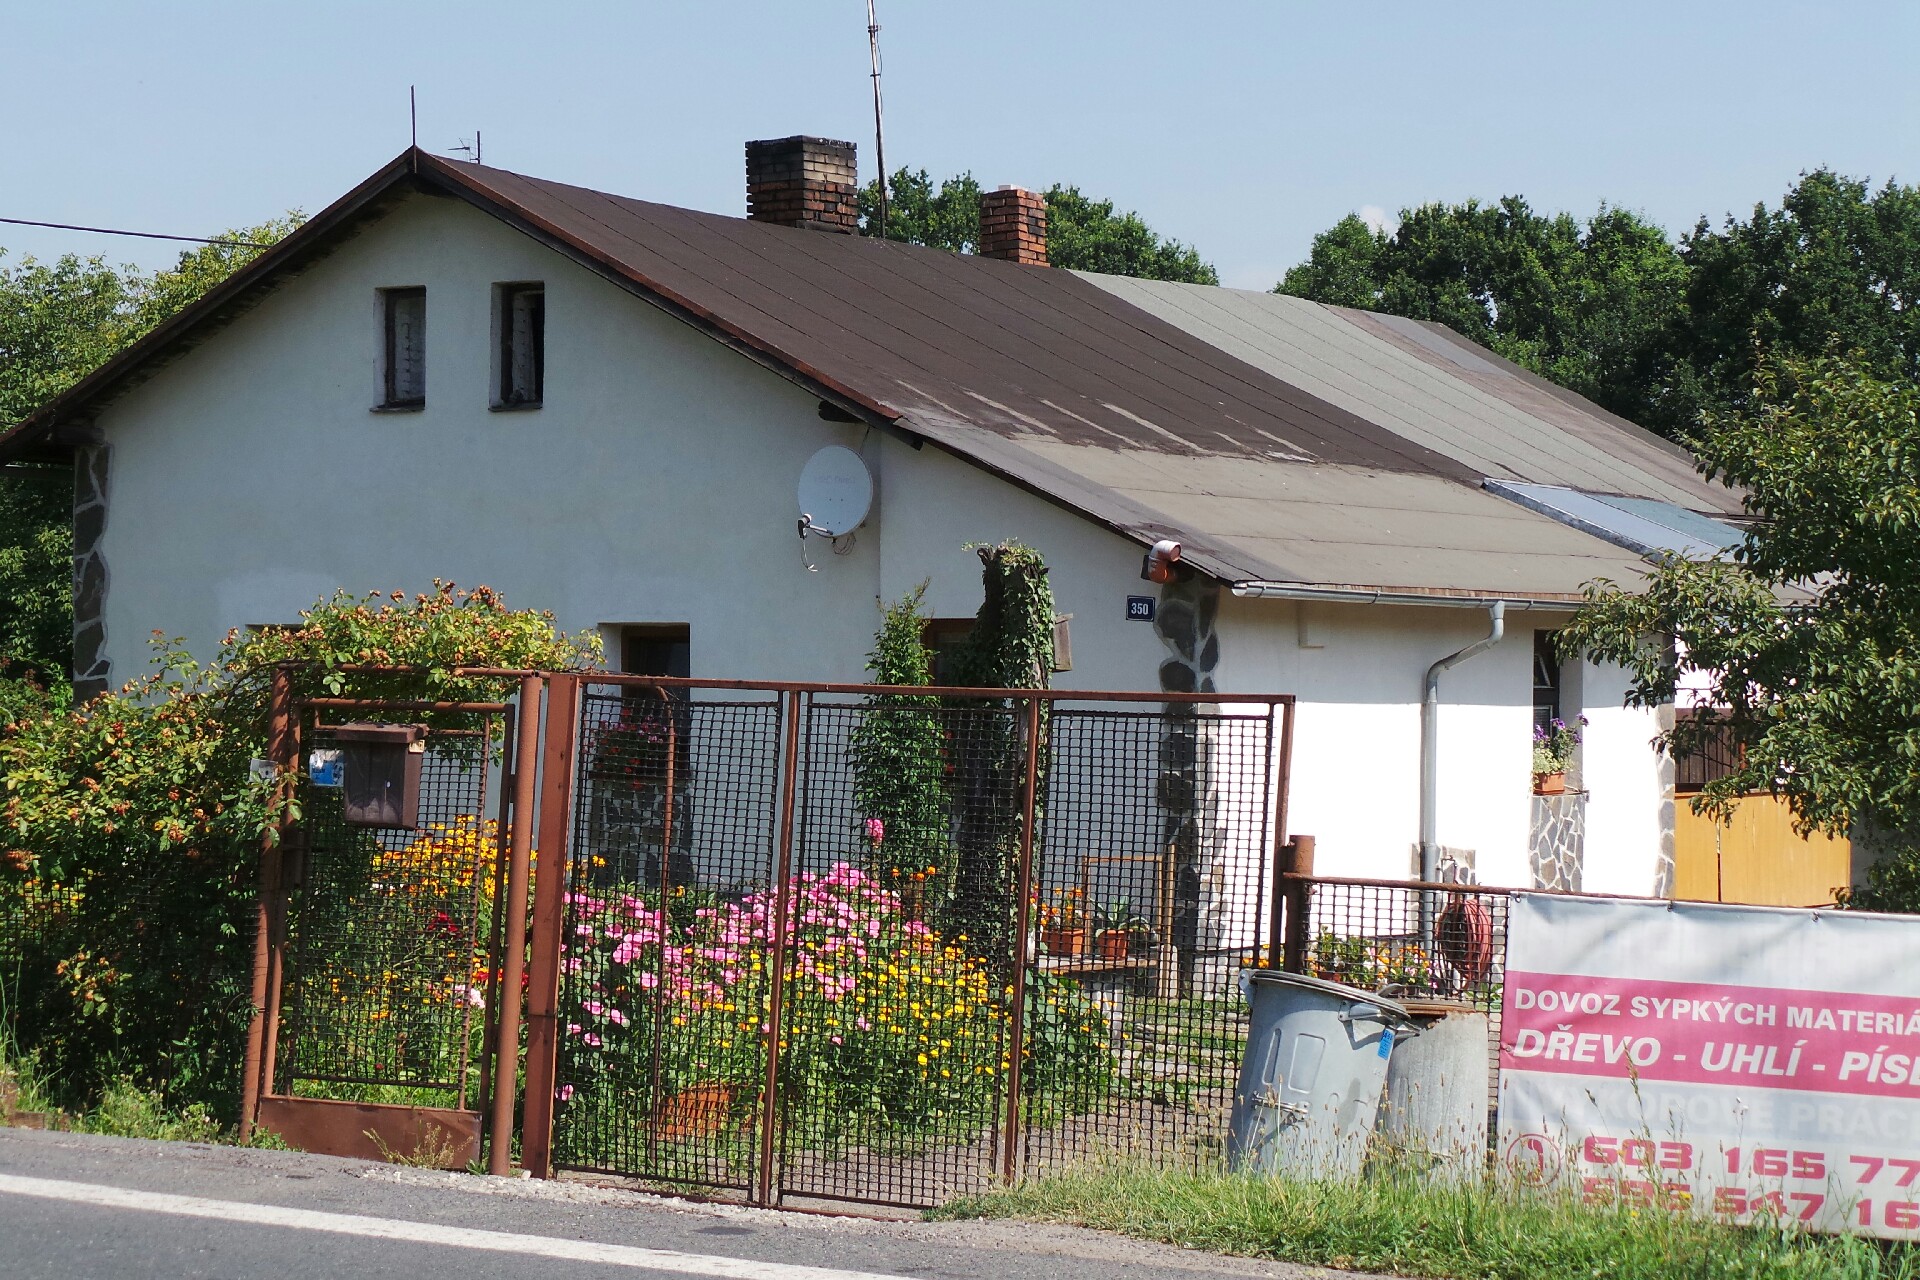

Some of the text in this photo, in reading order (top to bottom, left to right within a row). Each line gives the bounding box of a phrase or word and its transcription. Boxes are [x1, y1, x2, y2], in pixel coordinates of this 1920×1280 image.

[1131, 603, 1149, 615] 350
[1515, 988, 1621, 1016] DOVOZ
[1630, 996, 1776, 1026] SYPKÝCH
[1513, 1024, 1661, 1067] DŘEVO
[1700, 1040, 1808, 1077] UHLÍ
[1584, 1136, 1920, 1187] 603 165 77
[1714, 1187, 1824, 1220] 547
[1856, 1198, 1920, 1230] 16
